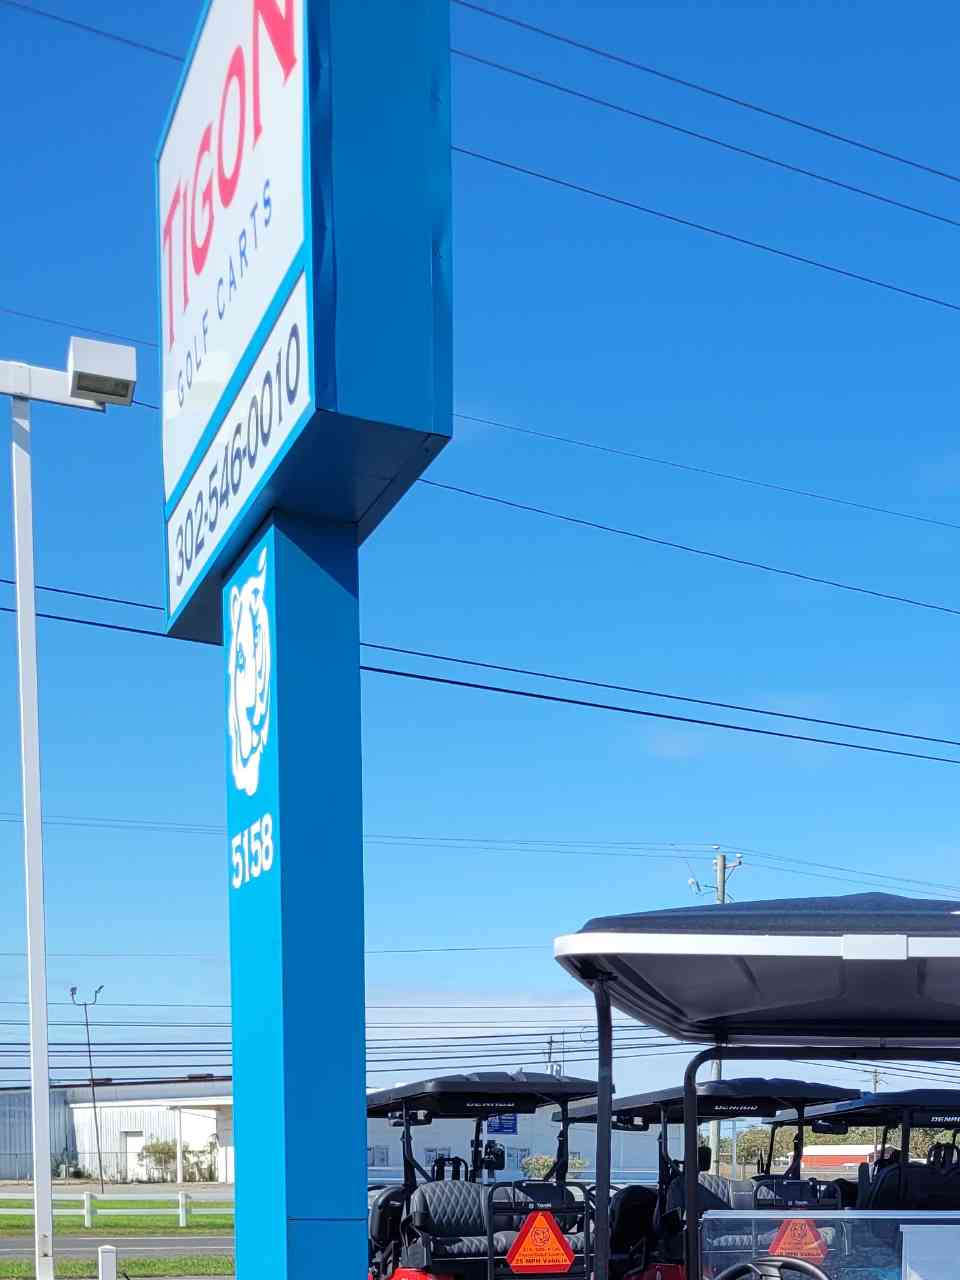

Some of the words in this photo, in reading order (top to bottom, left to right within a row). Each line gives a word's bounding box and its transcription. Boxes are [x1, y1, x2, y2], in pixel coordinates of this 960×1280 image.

[163, 0, 297, 353] TIGON
[177, 309, 208, 408] GOLF
[217, 179, 272, 321] CARTS
[232, 813, 273, 889] 5158
